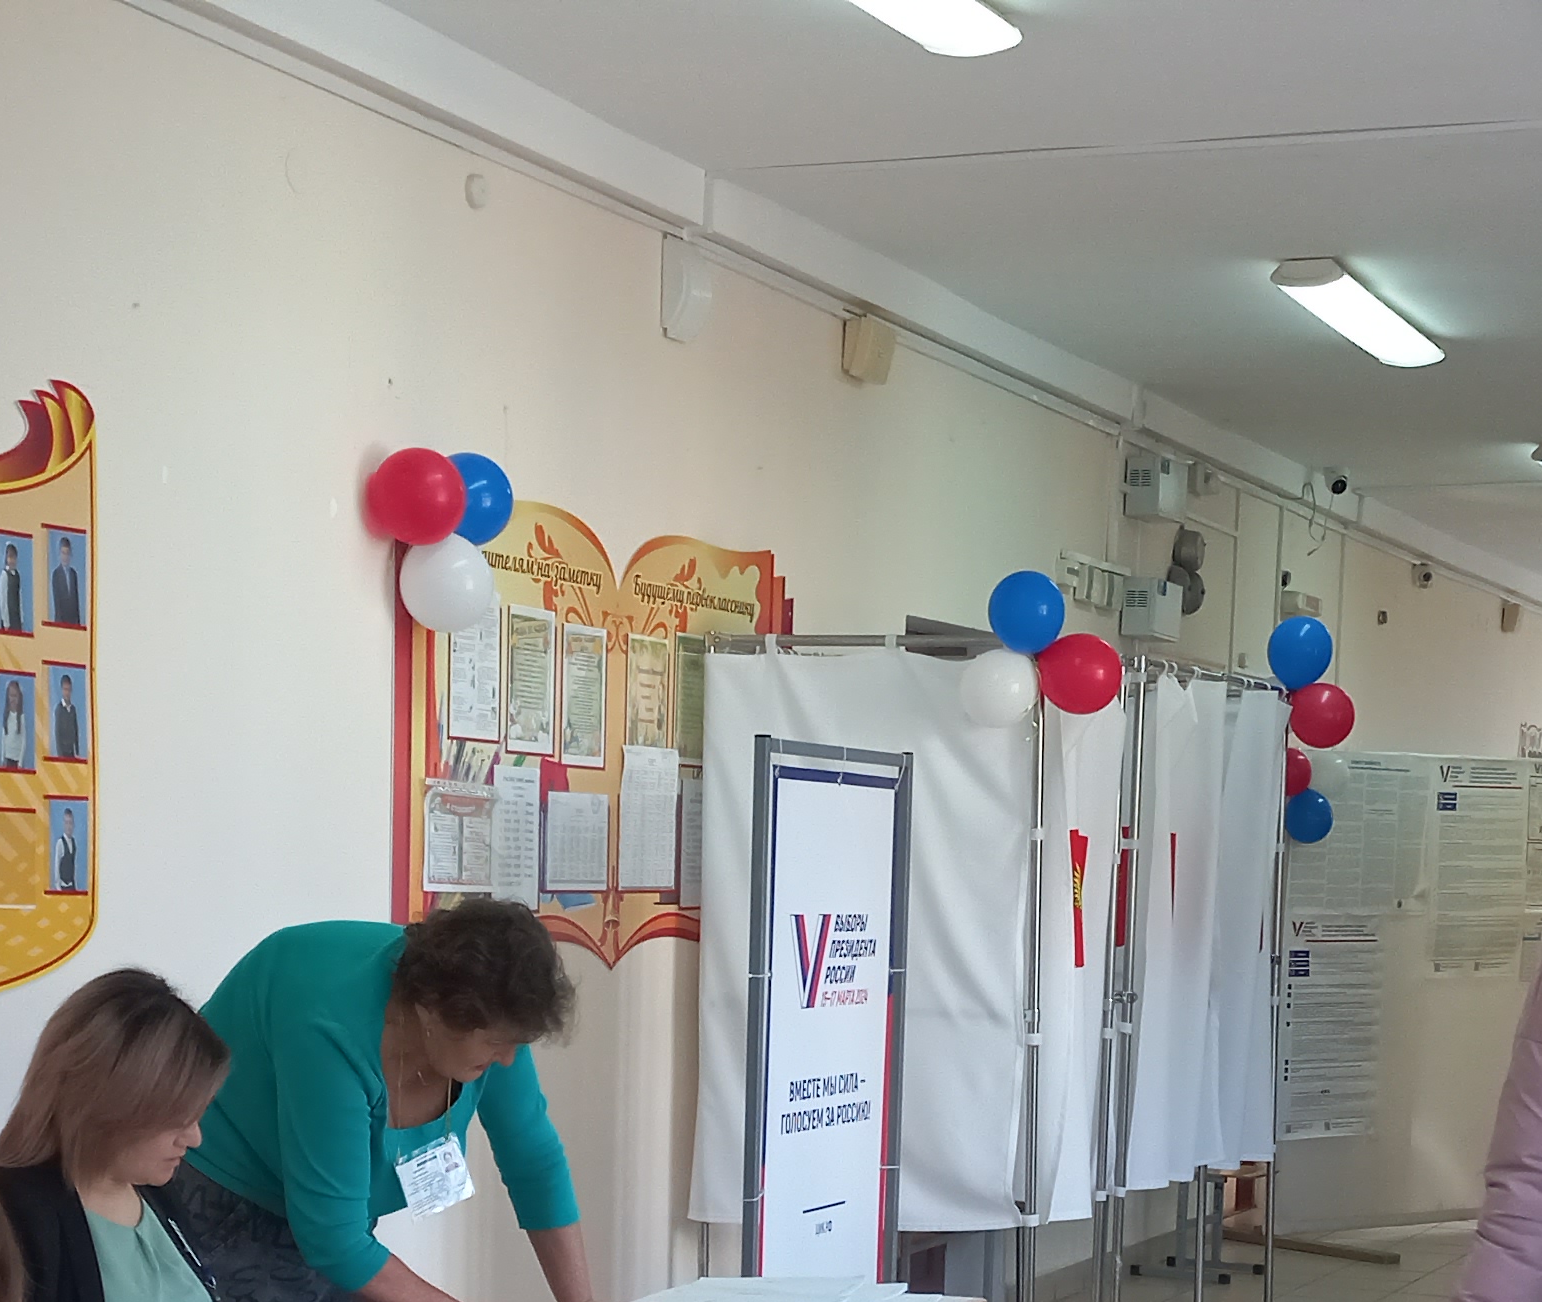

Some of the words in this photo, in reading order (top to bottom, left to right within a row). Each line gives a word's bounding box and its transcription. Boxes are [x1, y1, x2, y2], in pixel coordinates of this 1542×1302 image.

[536, 561, 551, 579] на
[551, 564, 602, 595] заметку
[634, 574, 685, 609] Будущему
[834, 913, 869, 932] ВЫБОРЫ
[829, 939, 877, 960] ПРЕЗИДЕНТА
[824, 965, 857, 984] РОССИИ
[789, 1078, 821, 1103] ВМЕСТЕ
[822, 1074, 838, 1098] МЫ
[839, 1072, 859, 1094] СИЛА
[781, 1107, 824, 1135] ГОЛОСУЕМ
[825, 1106, 836, 1127] ЗА
[836, 1100, 871, 1124] РОССИЮ!
